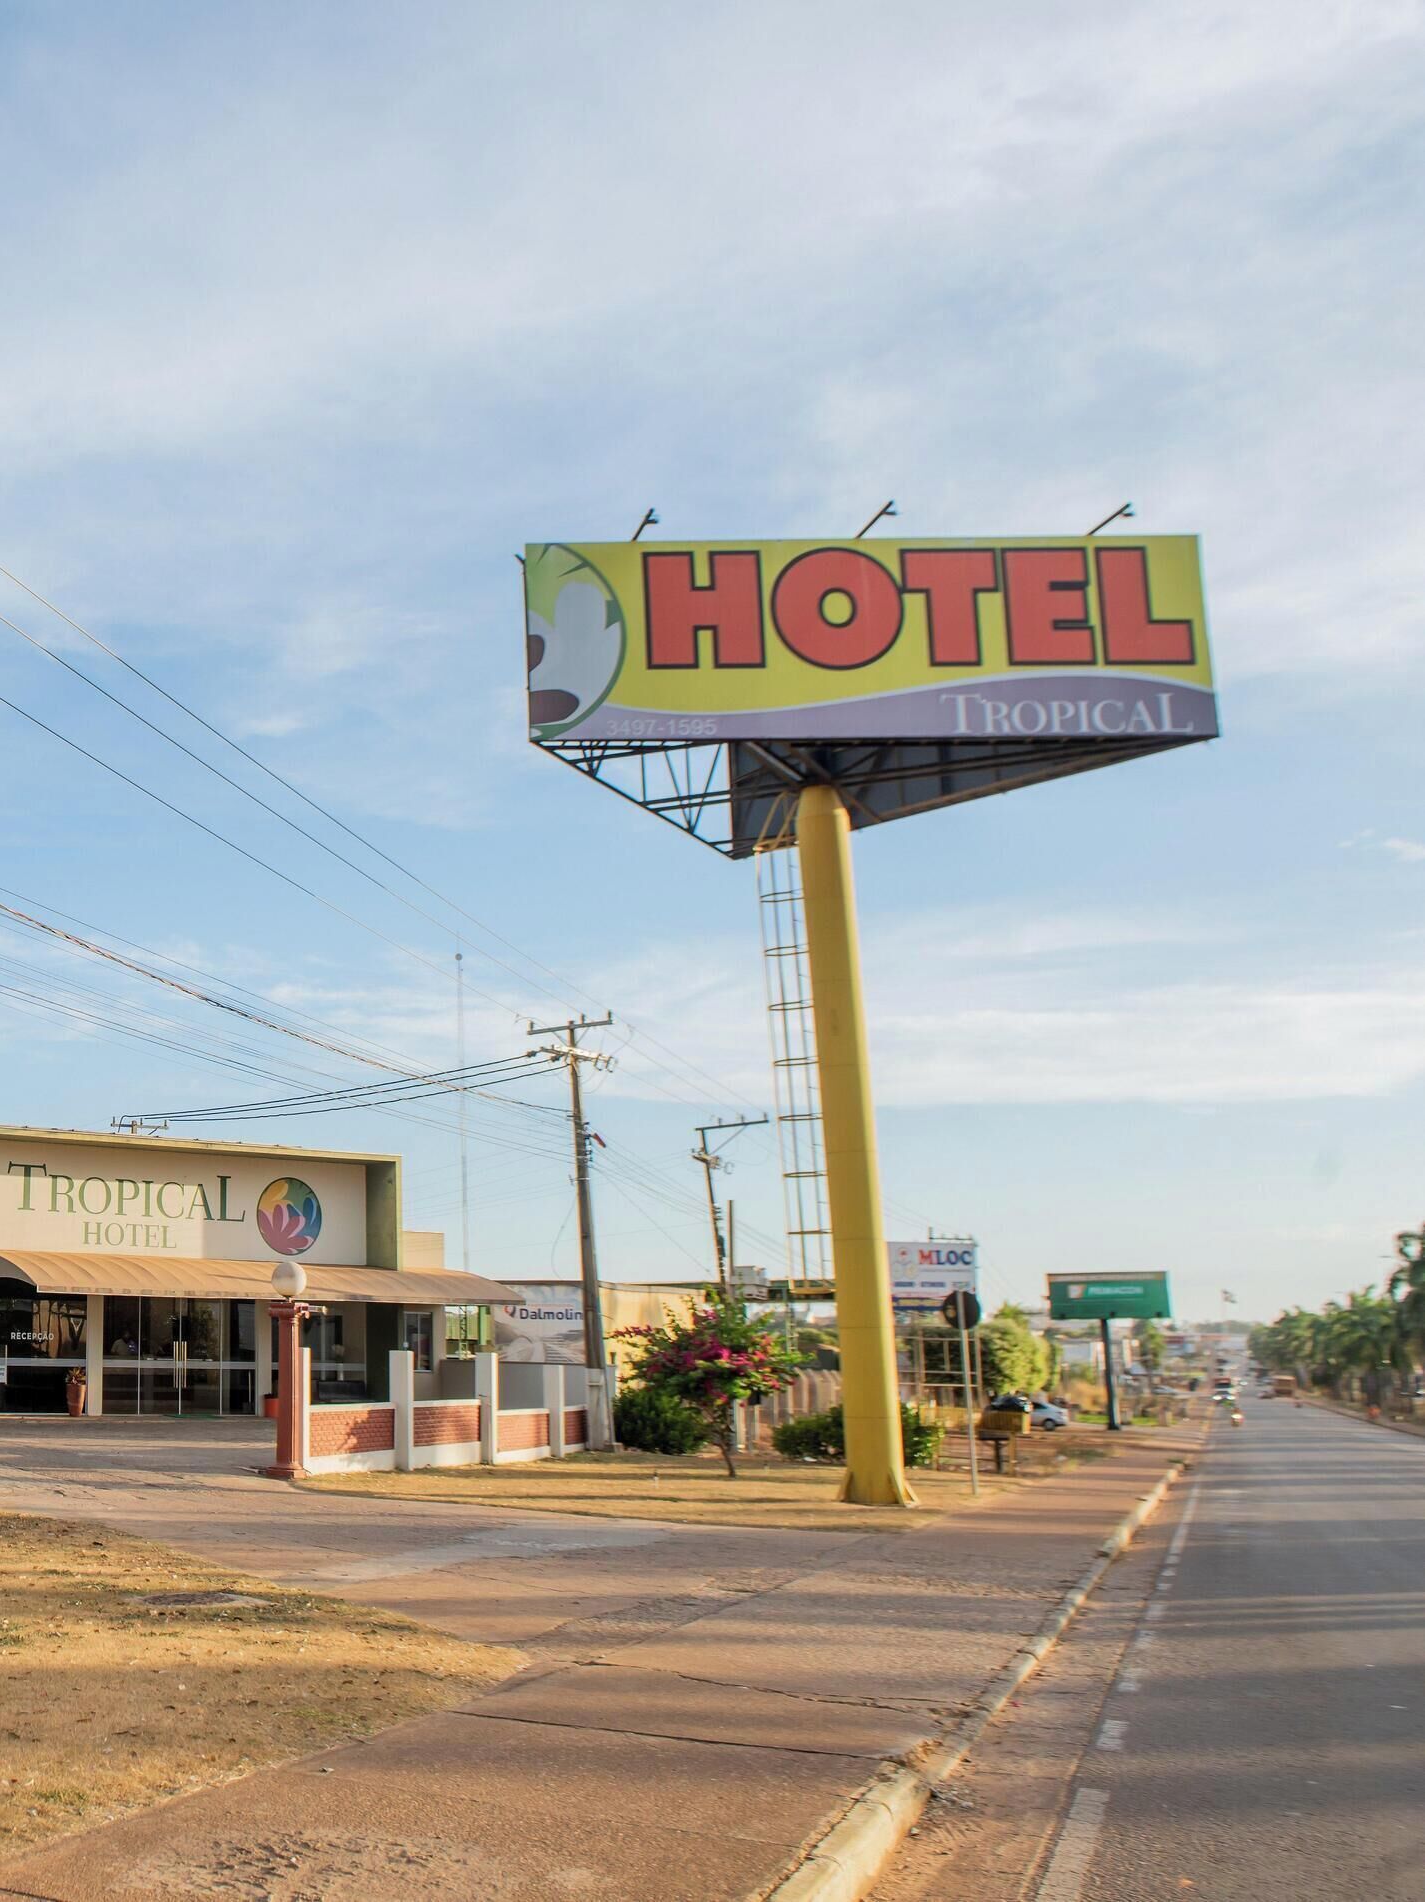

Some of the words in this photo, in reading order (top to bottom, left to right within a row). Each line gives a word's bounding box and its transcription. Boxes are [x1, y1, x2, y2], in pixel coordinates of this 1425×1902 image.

[642, 546, 1197, 671] HOTEL
[939, 692, 1194, 734] TROPICAL
[606, 719, 718, 736] 3497-1595
[7, 1160, 246, 1223] TROPICAL
[82, 1221, 177, 1249] HOTEL
[918, 1249, 973, 1265] MLOC
[519, 1308, 584, 1321] Dalmolin
[10, 1330, 55, 1343] RECEPÇÃO
